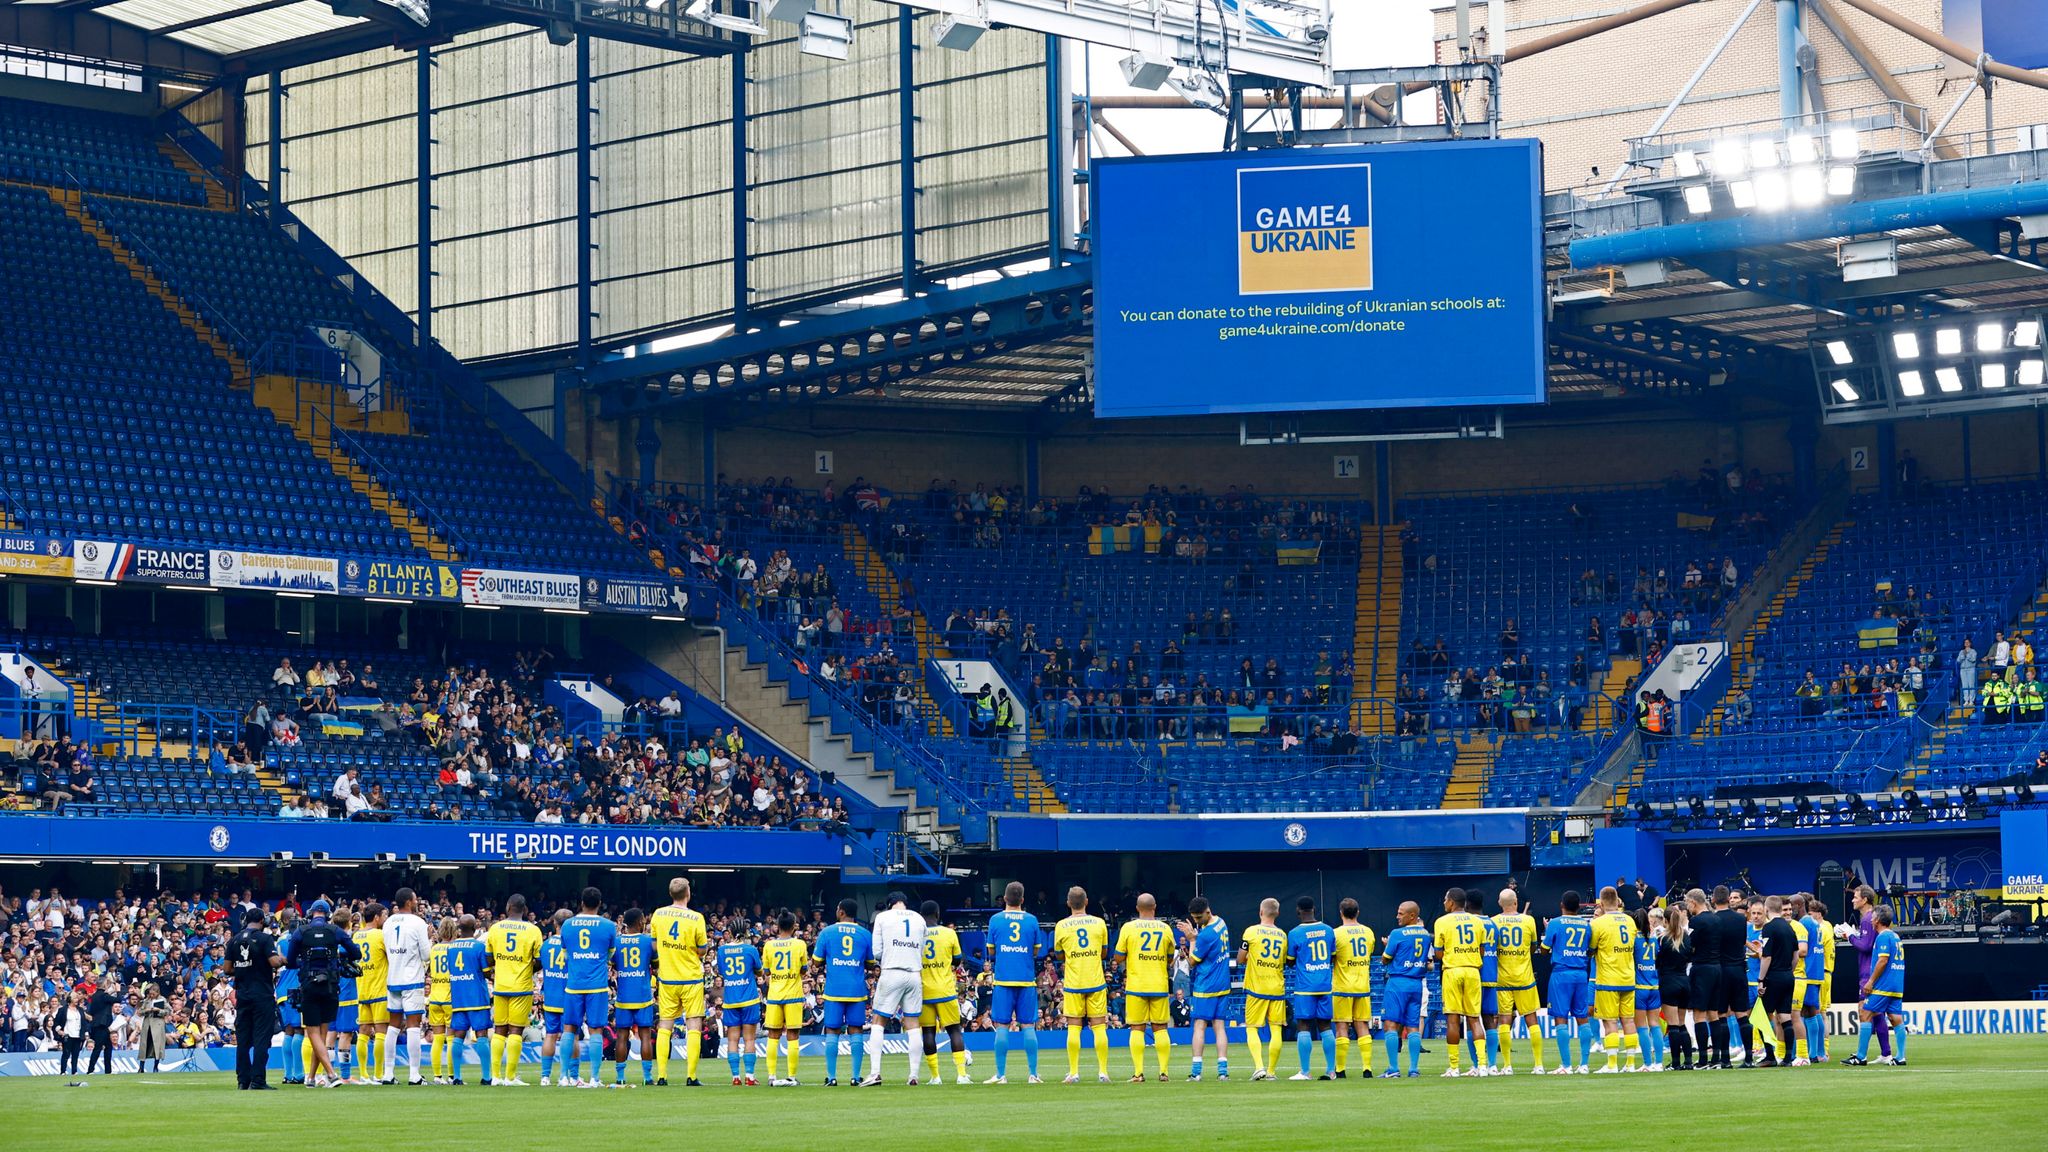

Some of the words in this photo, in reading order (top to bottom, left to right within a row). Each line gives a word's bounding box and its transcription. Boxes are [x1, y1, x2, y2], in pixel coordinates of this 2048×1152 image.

[1255, 204, 1352, 229] GAME4
[1250, 228, 1356, 254] UKRAINE
[1120, 308, 1147, 323] You
[1150, 309, 1175, 322] can
[1177, 306, 1227, 321] donate
[1229, 306, 1246, 319] to
[1248, 304, 1273, 318] the
[1275, 302, 1345, 320] rebuilding
[1347, 300, 1363, 314] of
[1365, 298, 1428, 313] Ukranian
[1430, 297, 1484, 311] schools
[1486, 297, 1506, 309] at:
[328, 330, 337, 345] 6
[1219, 319, 1406, 341] game4ukraine.com/donate
[818, 454, 830, 473] 1
[1337, 458, 1354, 477] 1A
[1854, 450, 1866, 469] 2
[5, 538, 36, 552] BLUES
[136, 549, 206, 571] FRANCE
[241, 552, 285, 569] Carefree
[285, 556, 334, 573] California
[136, 568, 185, 580] SUPPORTERS
[185, 571, 206, 581] CLUB
[369, 562, 434, 581] ATLANTA
[367, 579, 434, 598] BLUES
[546, 581, 579, 598] BLUES
[605, 584, 638, 606] AUSTIN
[639, 586, 668, 608] BLUES
[1696, 646, 1708, 666] 2
[955, 662, 965, 681] 1
[468, 832, 508, 854] THE
[514, 833, 575, 856] PRIDE
[580, 835, 599, 850] OF
[603, 836, 687, 857] LONDON
[2006, 884, 2045, 895] UKRAINE
[2007, 874, 2044, 886] GAME4
[571, 919, 601, 927] LESCOTT
[668, 920, 680, 941] 4
[902, 918, 910, 938] 1
[1008, 921, 1021, 943] 3
[394, 925, 401, 945] 1
[505, 932, 517, 953] 5
[578, 928, 591, 950] 6
[620, 937, 640, 945] DEFOE
[892, 938, 920, 949] Revolut
[1076, 928, 1089, 949] 8
[1140, 931, 1164, 952] 27
[1455, 924, 1475, 945] 15
[1499, 926, 1523, 948] 60
[1565, 927, 1587, 948] 27
[1619, 924, 1629, 945] 6
[662, 940, 688, 951] Revolut
[841, 935, 854, 957] 9
[1000, 944, 1028, 954] Revolut
[1070, 950, 1098, 959] Revolut
[1241, 941, 1248, 950] C
[1260, 938, 1283, 960] 35
[1308, 940, 1329, 962] 10
[1349, 937, 1367, 958] 16
[1414, 938, 1424, 957] 5
[1453, 946, 1479, 954] Revolut
[1498, 948, 1526, 957] Revolut
[1563, 949, 1587, 957] Revolut
[1642, 941, 1656, 961] 21
[433, 954, 449, 974] 18
[455, 950, 464, 971] 4
[495, 952, 523, 963] Revolut
[548, 947, 566, 970] 14
[572, 951, 600, 960] Revolut
[620, 946, 641, 968] 18
[774, 951, 791, 970] 21
[832, 958, 860, 967] Revolut
[922, 961, 945, 969] evolut
[1138, 953, 1165, 962] Revolut
[617, 969, 646, 978] Revolut
[724, 956, 746, 976] 35
[449, 973, 475, 982] Revolut
[723, 979, 750, 987] Revolut
[771, 973, 797, 981] Revolut
